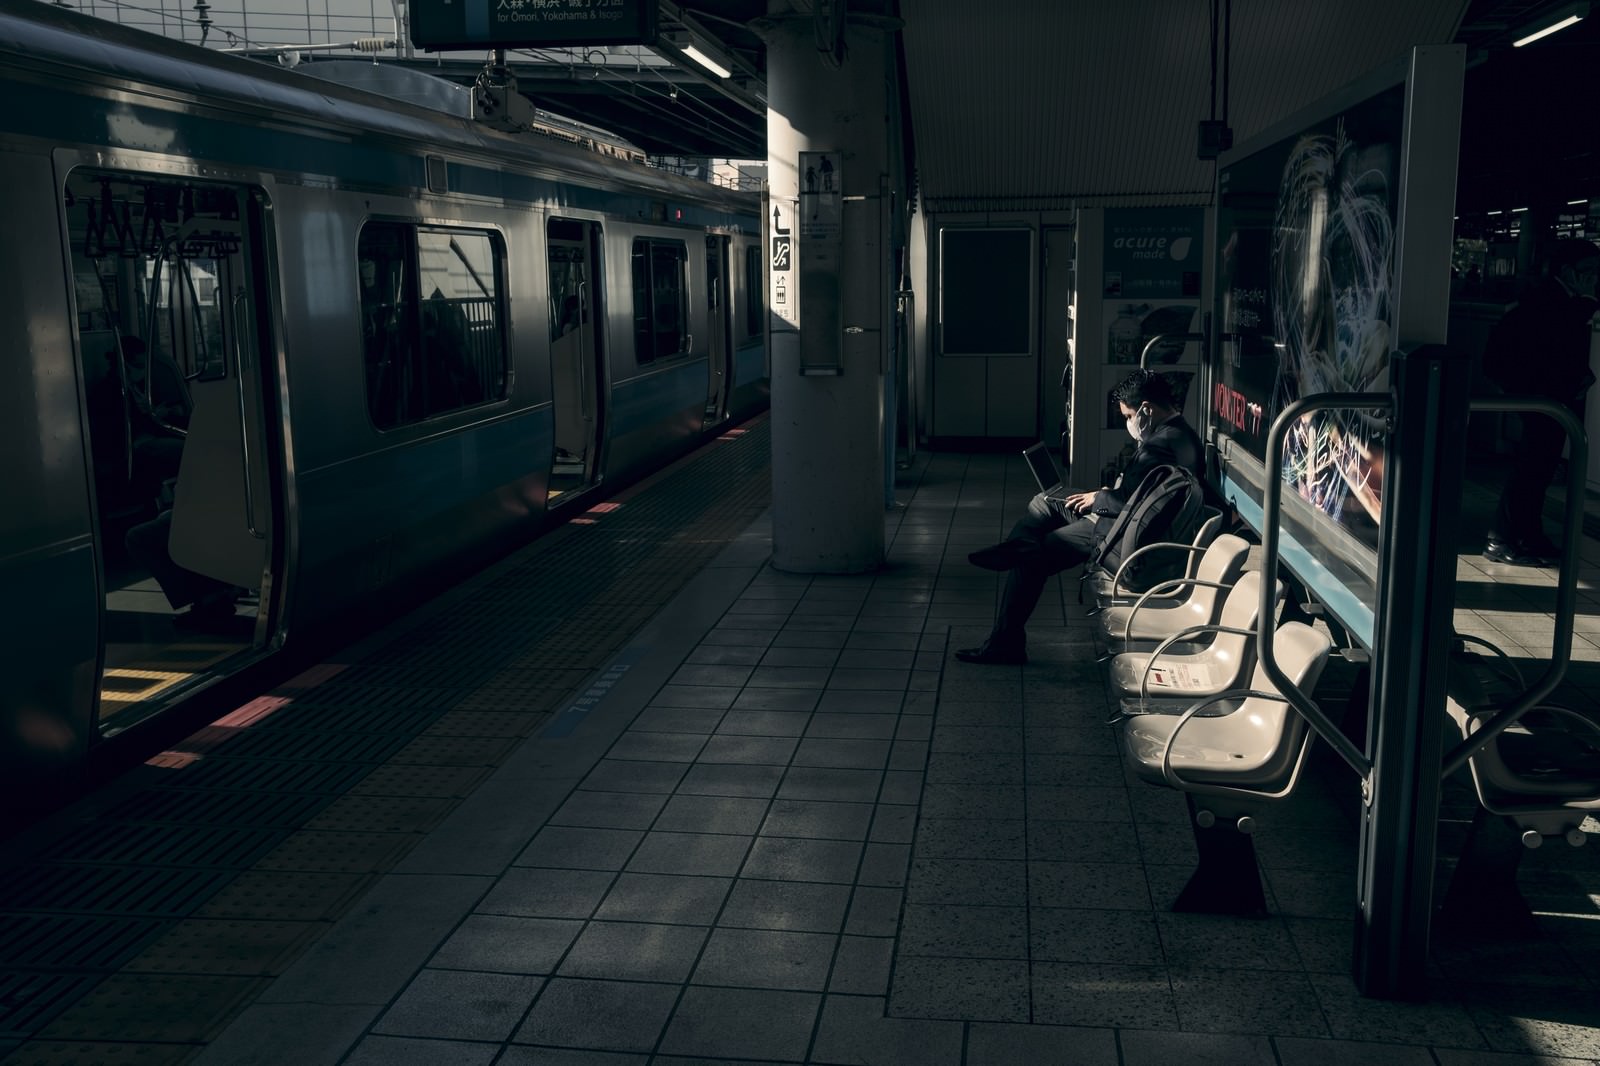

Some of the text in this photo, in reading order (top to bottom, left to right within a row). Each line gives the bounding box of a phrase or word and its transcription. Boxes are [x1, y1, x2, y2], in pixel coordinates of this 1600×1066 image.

[497, 12, 509, 22] for
[543, 10, 588, 21] Yokohama
[590, 9, 597, 19] &
[1113, 236, 1167, 249] acure
[1132, 249, 1166, 260] made
